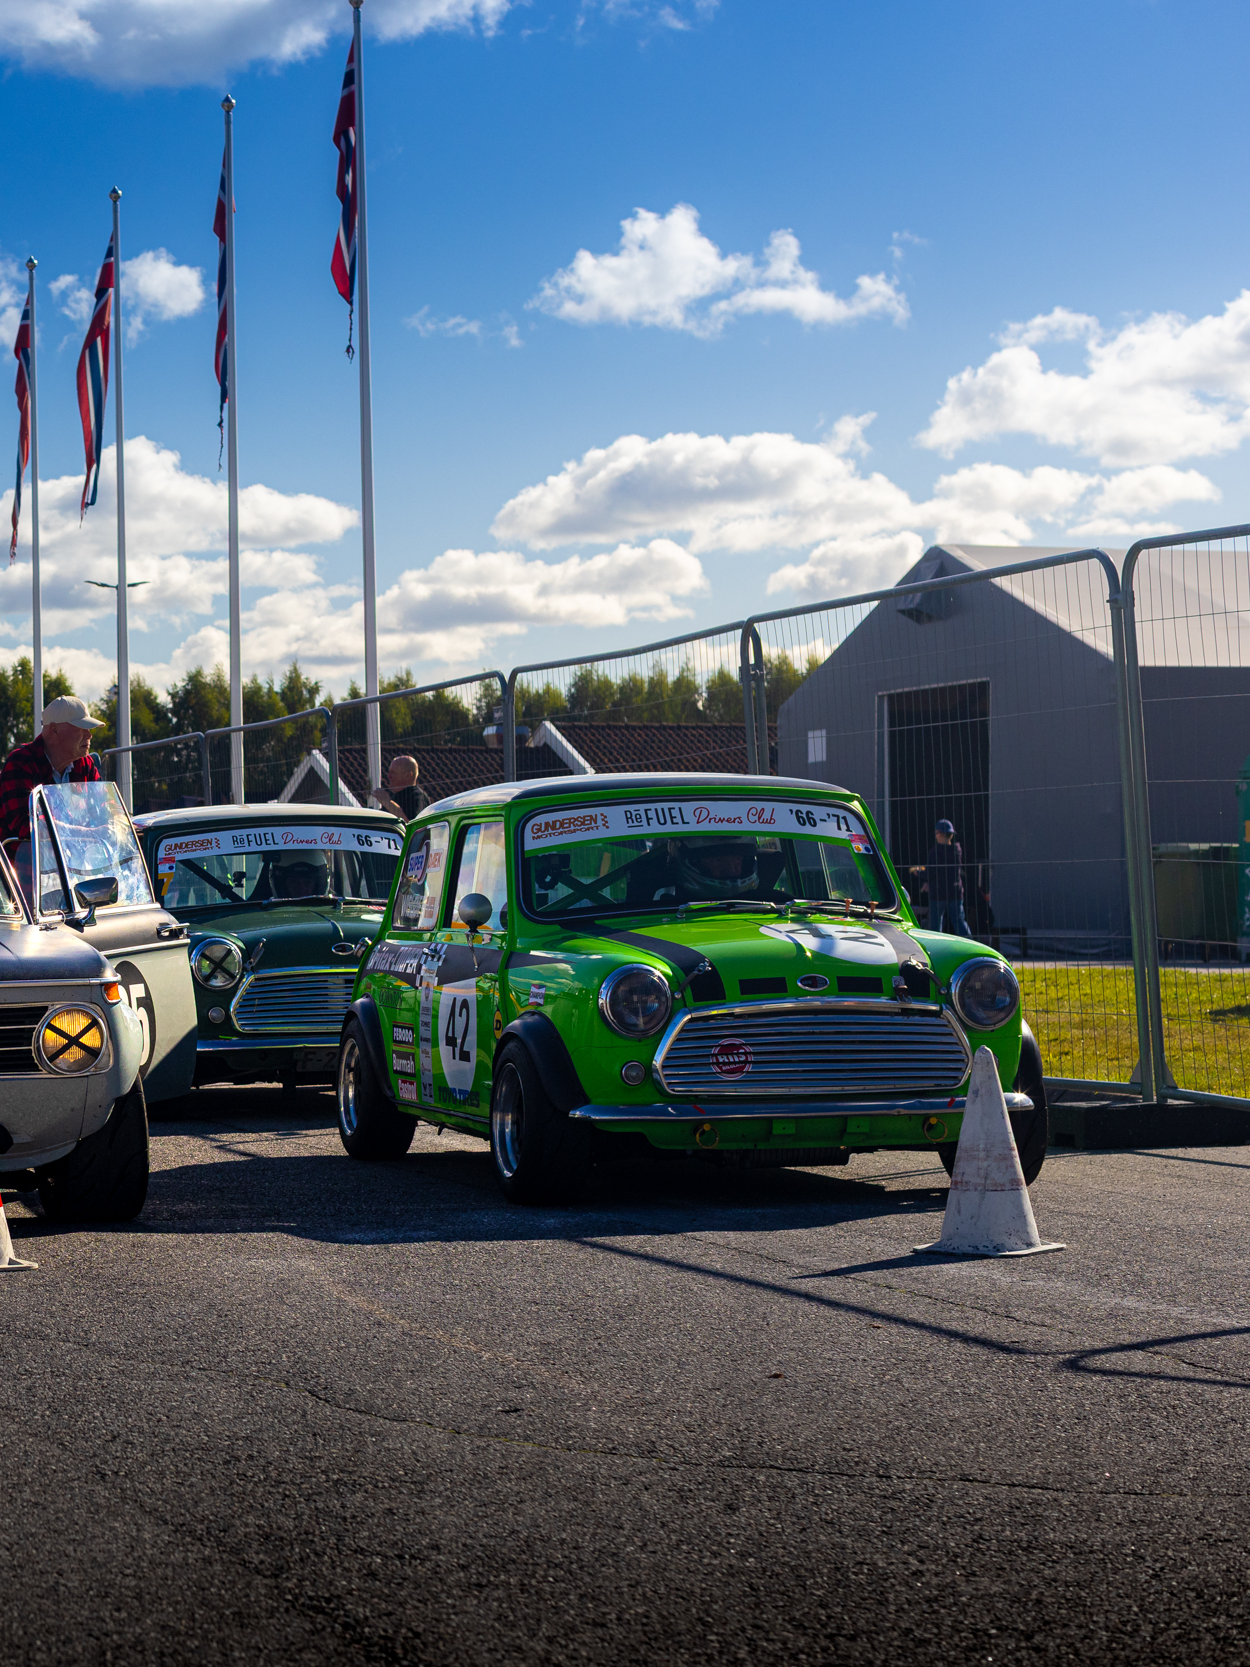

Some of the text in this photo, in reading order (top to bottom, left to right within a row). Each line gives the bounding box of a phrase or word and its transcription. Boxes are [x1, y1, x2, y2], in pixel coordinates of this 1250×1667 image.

[530, 813, 598, 835] GUNDERSEN
[693, 806, 743, 825] Drivers
[746, 806, 776, 825] Club
[281, 831, 318, 845] Drivers
[320, 832, 343, 845] Club
[531, 825, 601, 841] MOTORSPORT
[163, 838, 213, 852] GUNDERSEN
[164, 846, 215, 857] MOTORSPORT
[784, 927, 886, 948] 42
[393, 1026, 413, 1043] FERODO
[445, 997, 471, 1063] 42
[494, 1019, 501, 1031] D
[392, 1053, 415, 1074] Burmah
[397, 1078, 417, 1100] Castrol
[437, 1086, 480, 1108] TOYO TIRES
